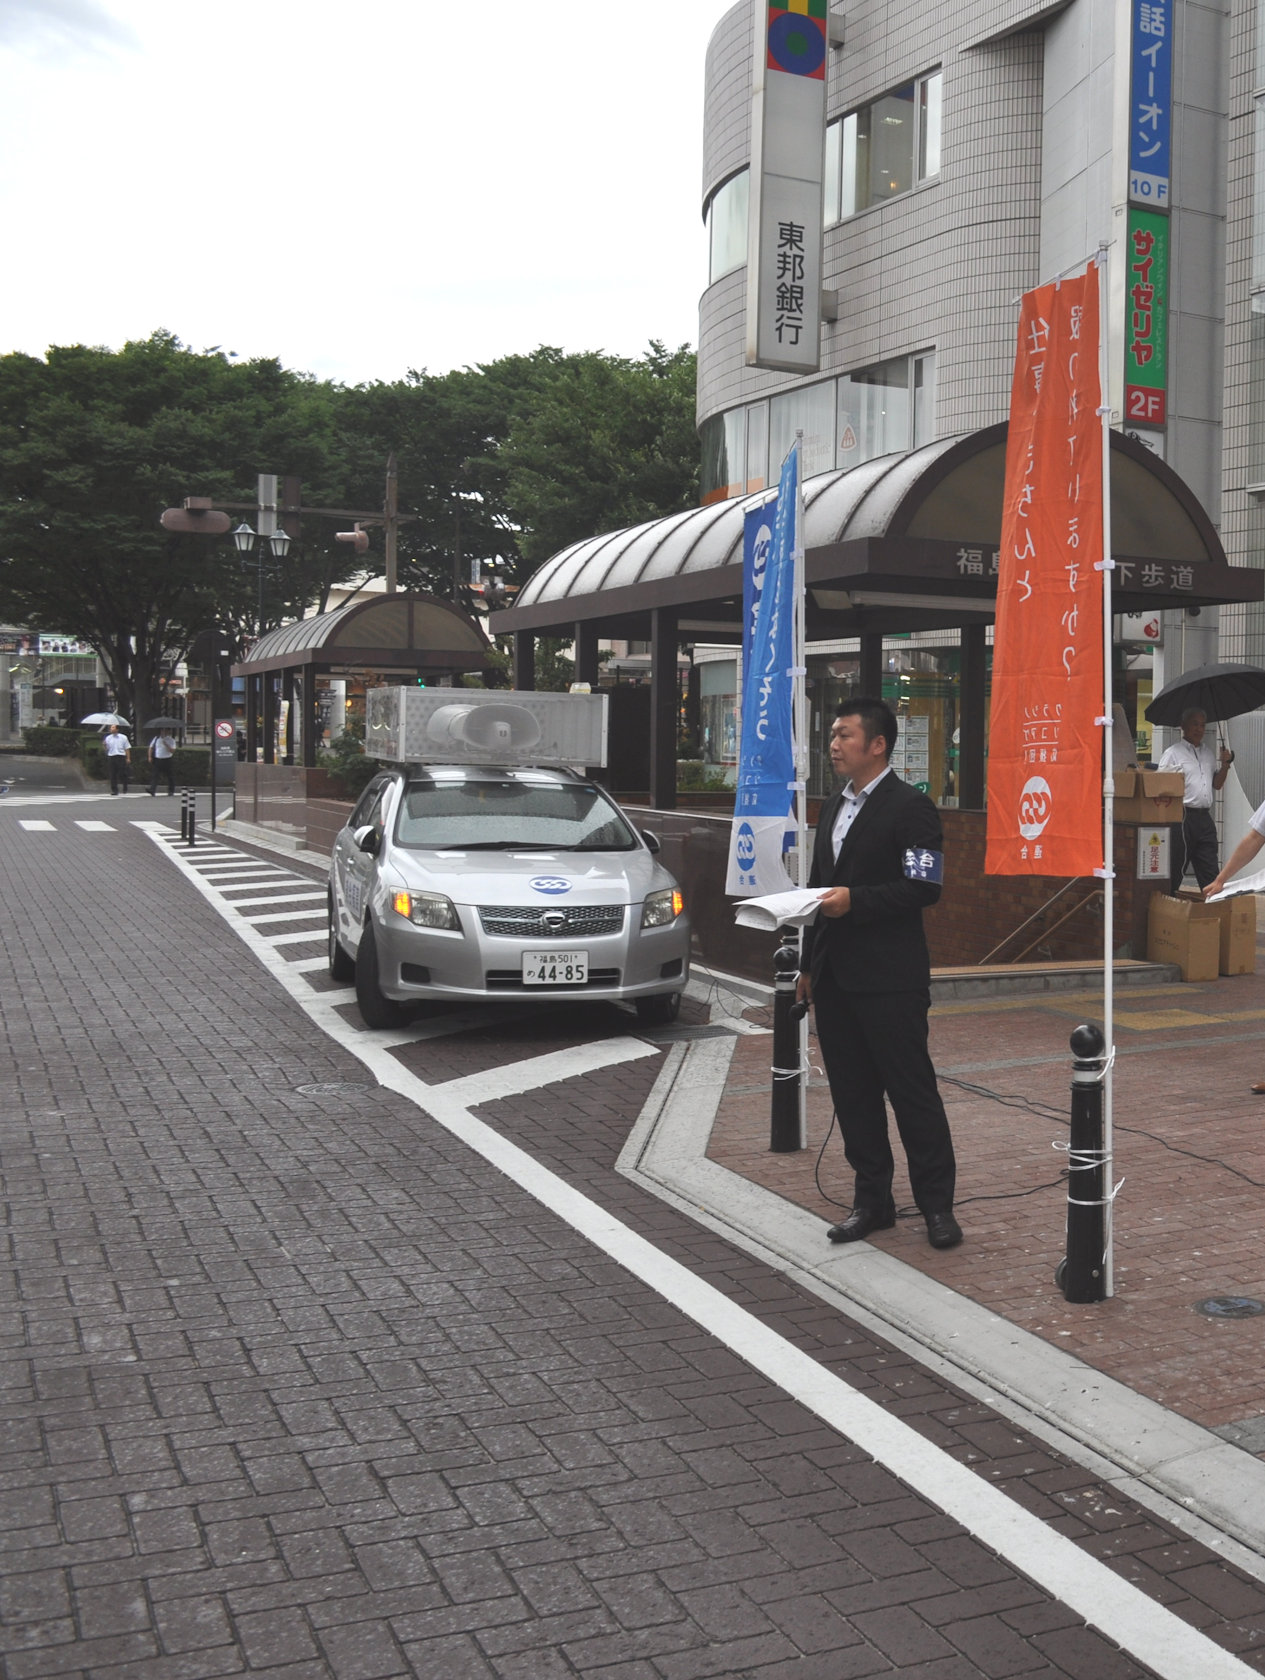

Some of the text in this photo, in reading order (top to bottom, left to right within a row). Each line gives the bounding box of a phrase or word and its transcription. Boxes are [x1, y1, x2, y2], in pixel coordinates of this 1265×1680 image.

[1139, 0, 1165, 158] 話イーオン
[775, 221, 805, 346] 東邦銀行
[1130, 229, 1155, 366] サイゼリヤ
[1130, 390, 1161, 418] 2F
[537, 964, 585, 982] 44-85
